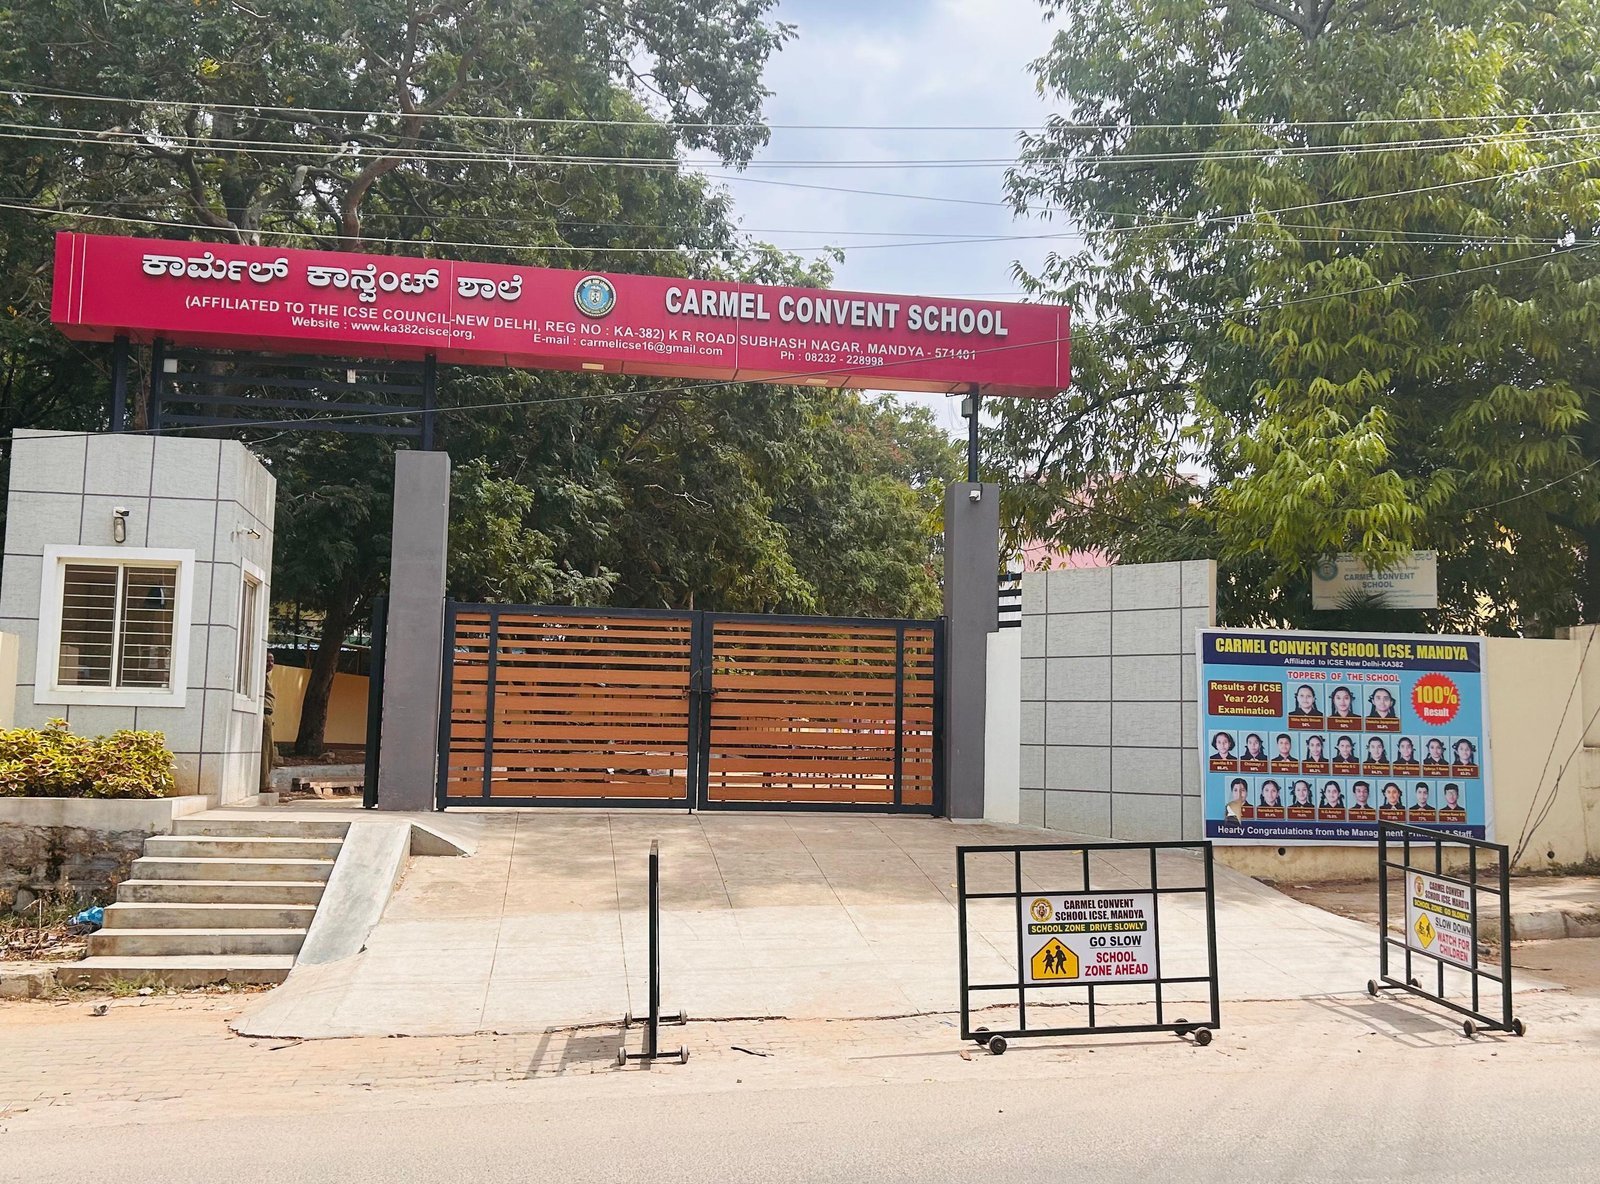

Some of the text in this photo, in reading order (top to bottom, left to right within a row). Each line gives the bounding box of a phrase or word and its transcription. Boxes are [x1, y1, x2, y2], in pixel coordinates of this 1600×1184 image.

[142, 251, 523, 303] ಕಾರ್ಮೆಲ್ ಕಾನ್ವೆಂಟ್ ಶಾಲೆ
[665, 286, 1008, 336] CARMEL CONVENT SCHOOL
[185, 295, 280, 312] (AFFILIATED
[284, 301, 304, 314] TO
[309, 303, 338, 316] THE
[343, 306, 378, 319] ICSE
[494, 317, 541, 331] DELHI,
[545, 320, 576, 334] REG
[580, 323, 601, 335] NO
[614, 326, 665, 342] KA-382)
[669, 330, 678, 341] K
[682, 331, 691, 342] R
[696, 332, 736, 345] ROAD
[740, 335, 807, 350] SUBHASH
[811, 340, 863, 354] NAGAR,
[868, 343, 924, 357] MANDYA
[935, 348, 977, 360] 571401
[291, 316, 340, 329] Website
[533, 334, 570, 345] E-mail
[580, 337, 723, 356] carmelicse16@gmail.com
[780, 350, 795, 360] Ph
[805, 352, 836, 363] 08232
[846, 355, 884, 365] 228998
[1344, 573, 1376, 581] CARMEL
[1215, 637, 1468, 660] CARMEL CONVENT SCHOOL ICSE, MANDYA
[1284, 657, 1315, 665] Affiliated
[1362, 659, 1404, 668] Delhi-KA382
[1288, 671, 1400, 682] TOPPERS OF THE SCHOOL
[1211, 682, 1282, 692] Results of ICSE
[1223, 694, 1270, 704] Year 2024
[1415, 685, 1458, 704] 100%
[1218, 705, 1275, 715] Examination
[1423, 706, 1450, 717] Result
[1217, 825, 1245, 836] Hearty
[1247, 826, 1313, 837] Congratulations
[1315, 827, 1334, 836] from
[1336, 828, 1349, 836] the
[1429, 881, 1445, 894] CARMEL
[1425, 890, 1440, 902] SCHOOL
[1063, 899, 1096, 910] CARMEL
[1098, 898, 1134, 909] CONVENT
[1055, 910, 1087, 921] SCHOOL
[1111, 909, 1144, 920] MANDYA
[1031, 922, 1145, 933] SCHOOL ZONE DRIVE SLOWLY
[1435, 917, 1471, 936] SLOW DOWN
[1089, 935, 1142, 947] GO SLOW
[1437, 931, 1470, 951] WATCH FOR
[1096, 951, 1136, 963] SCHOOL
[1440, 944, 1468, 962] CHILDREN
[1085, 963, 1148, 976] ZONE AHEAD
